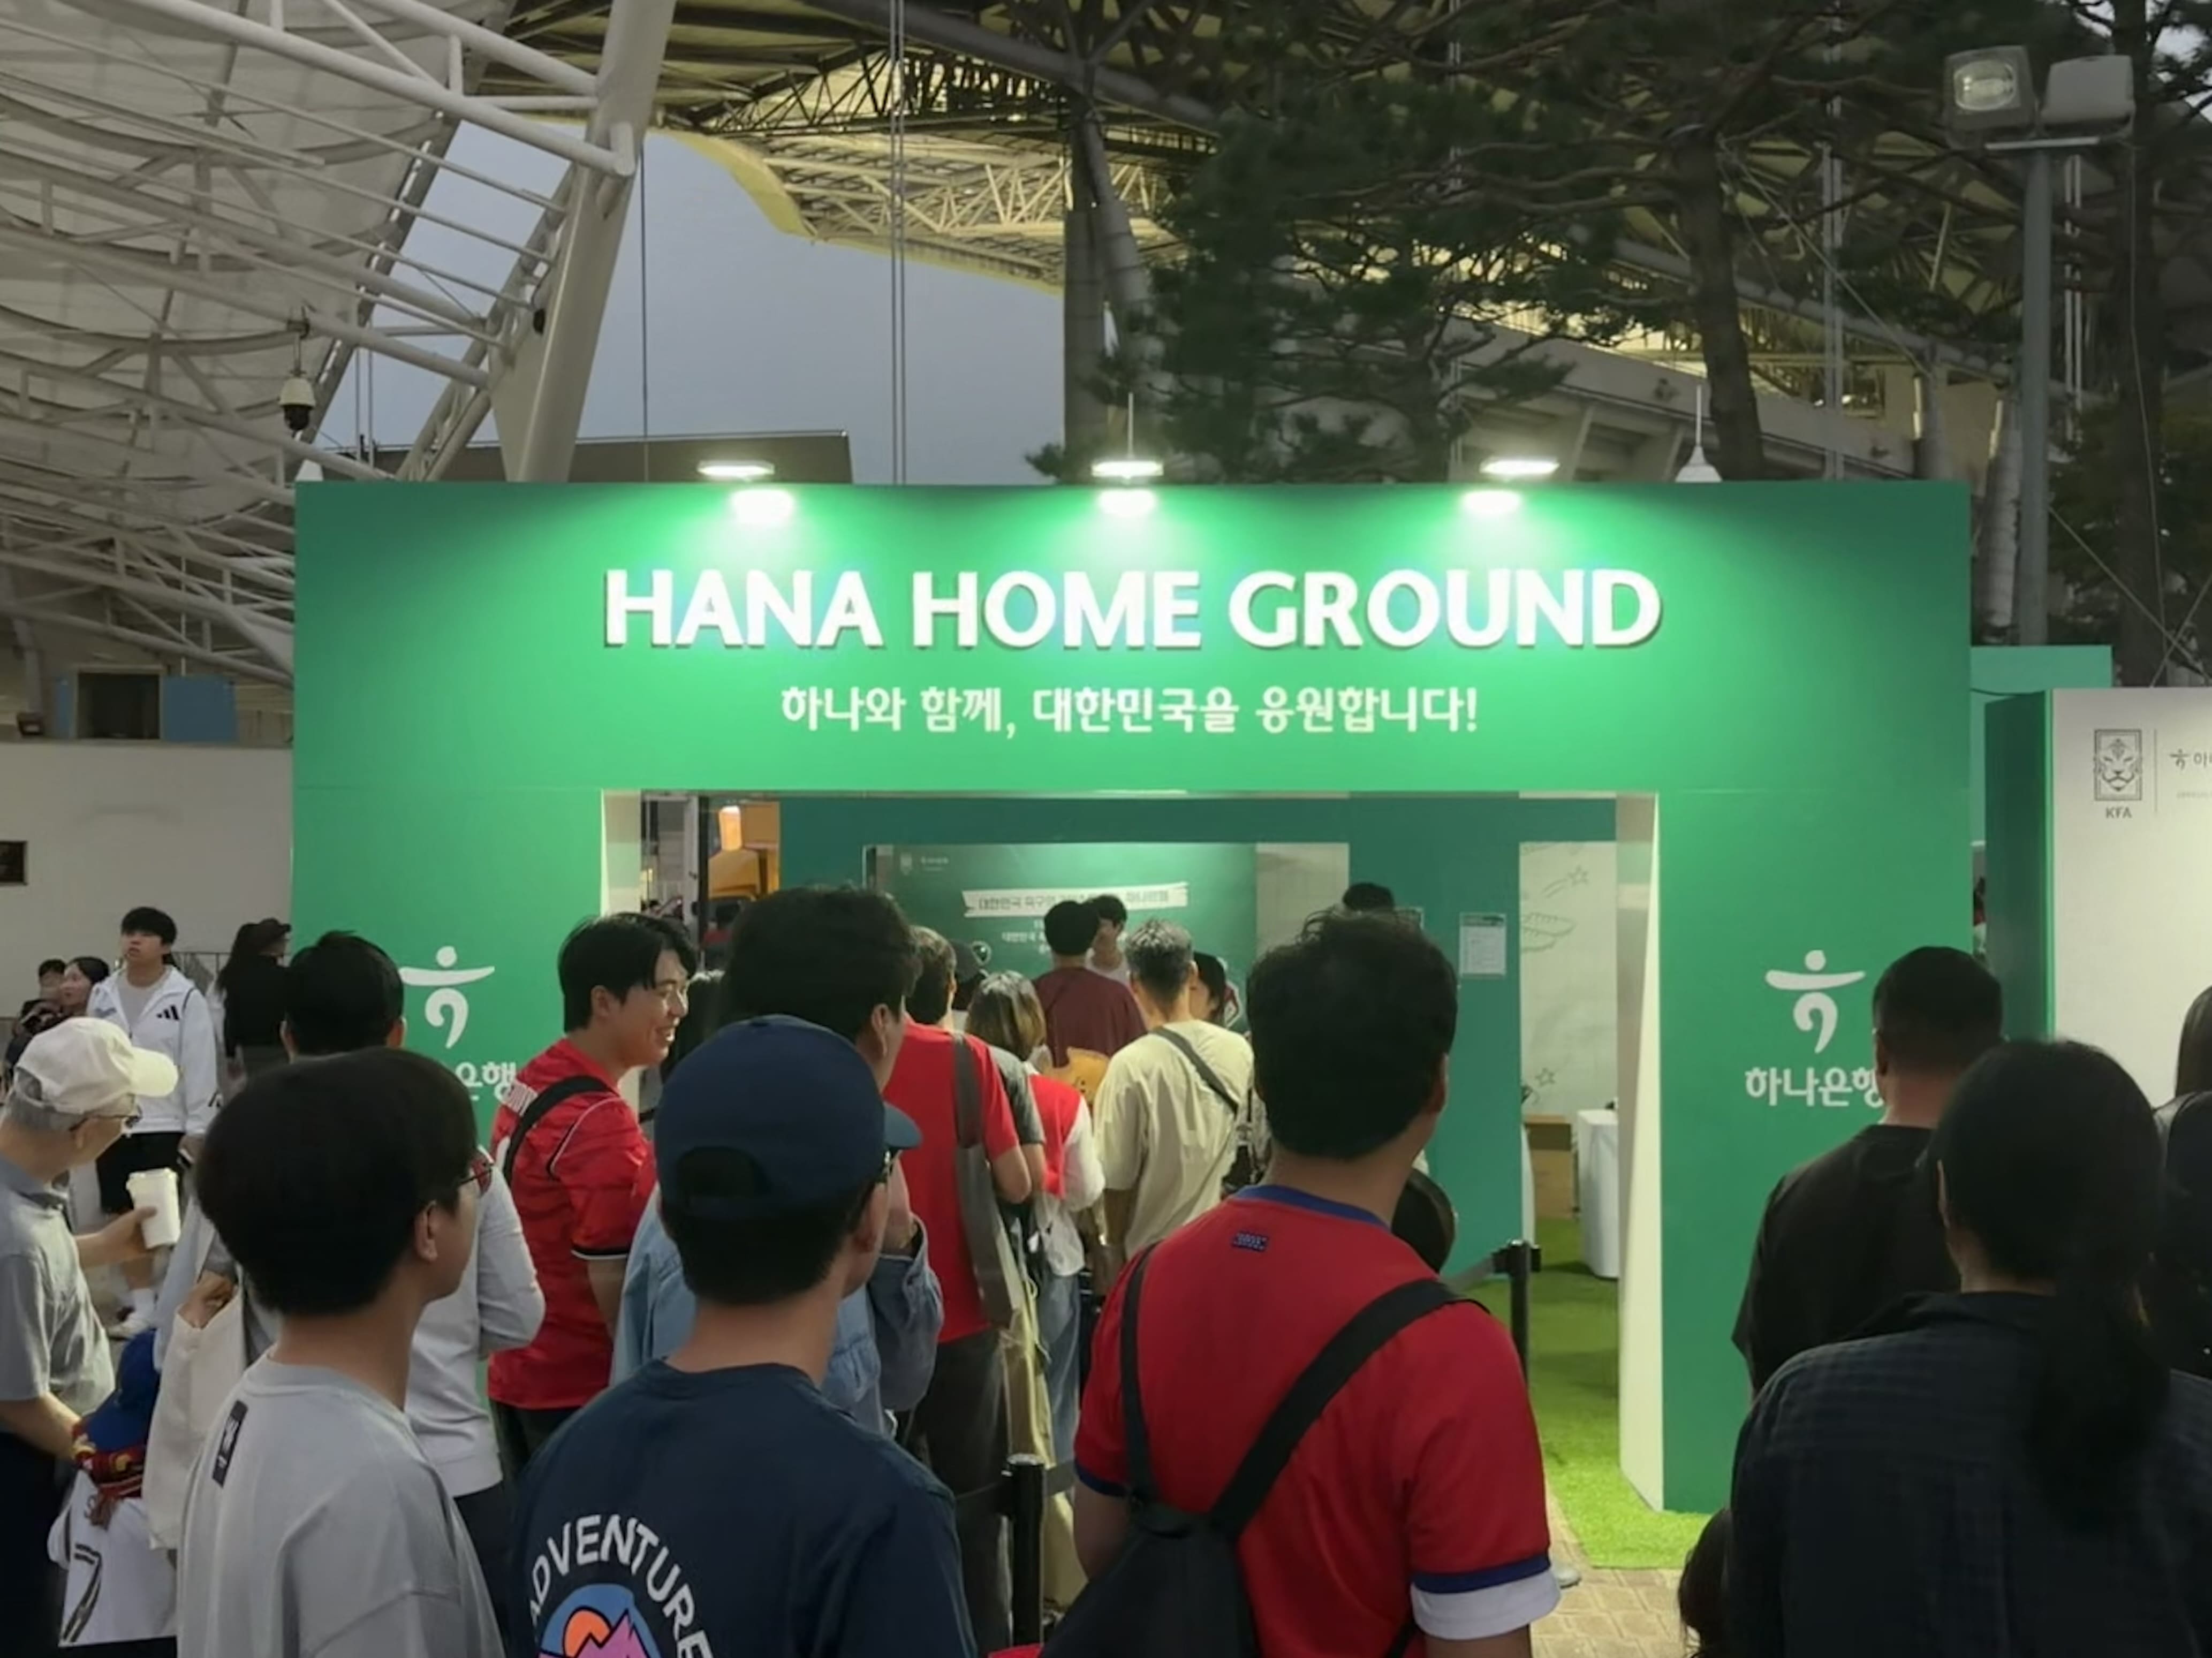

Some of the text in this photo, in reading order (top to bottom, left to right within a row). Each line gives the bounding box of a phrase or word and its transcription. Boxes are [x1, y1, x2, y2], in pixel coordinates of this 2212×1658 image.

[604, 568, 1662, 649] HANA HOME GROUND
[781, 686, 1479, 739] 하나와 함께, 대한민국을 응원합니다!
[2105, 806, 2133, 819] KFA
[455, 1061, 517, 1101] 은행
[1745, 1067, 1884, 1107] 하나은행
